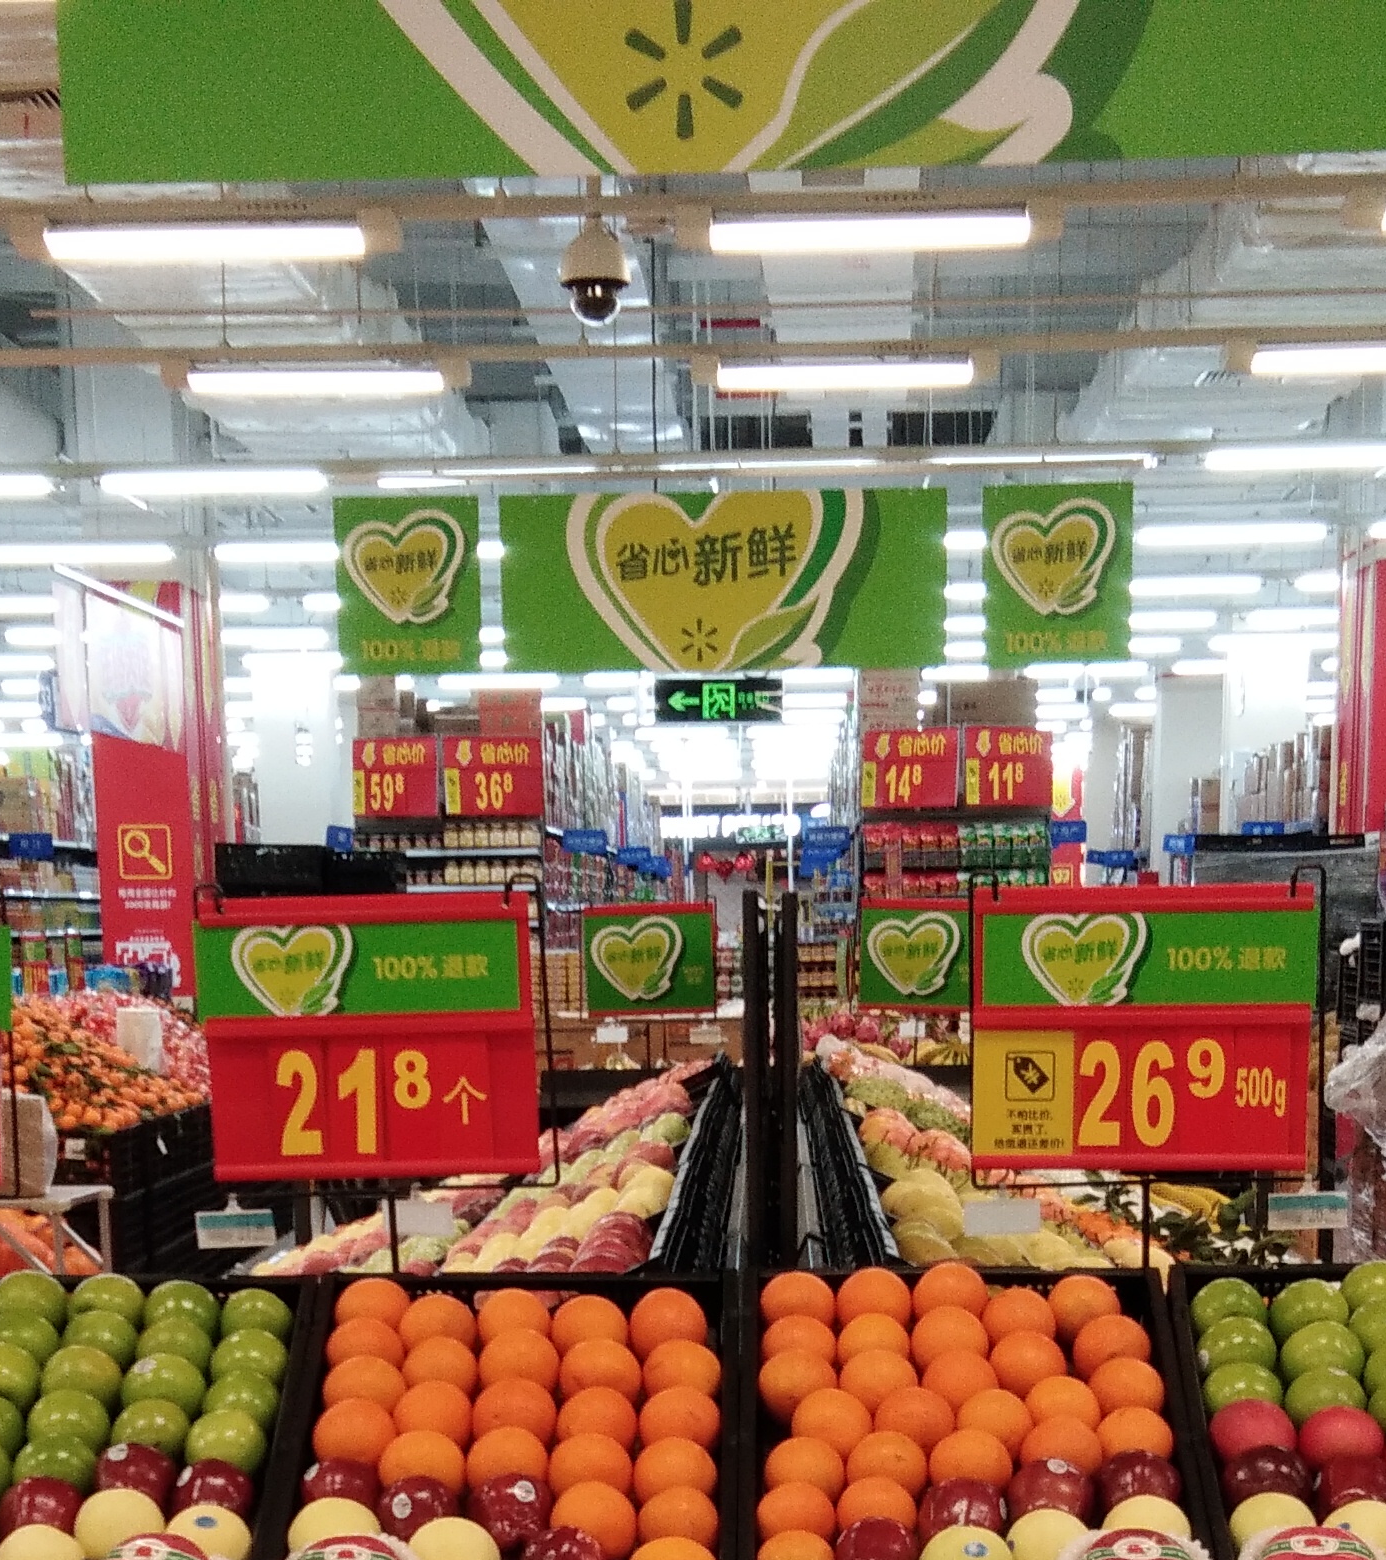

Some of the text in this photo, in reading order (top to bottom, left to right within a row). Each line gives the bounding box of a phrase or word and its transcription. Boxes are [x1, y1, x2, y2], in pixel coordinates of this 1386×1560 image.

[615, 521, 798, 586] 省心新鲜
[372, 956, 438, 981] 100%
[1166, 946, 1287, 972] 100% 退款
[442, 1075, 488, 1126] 个
[1235, 1066, 1287, 1118] 500g
